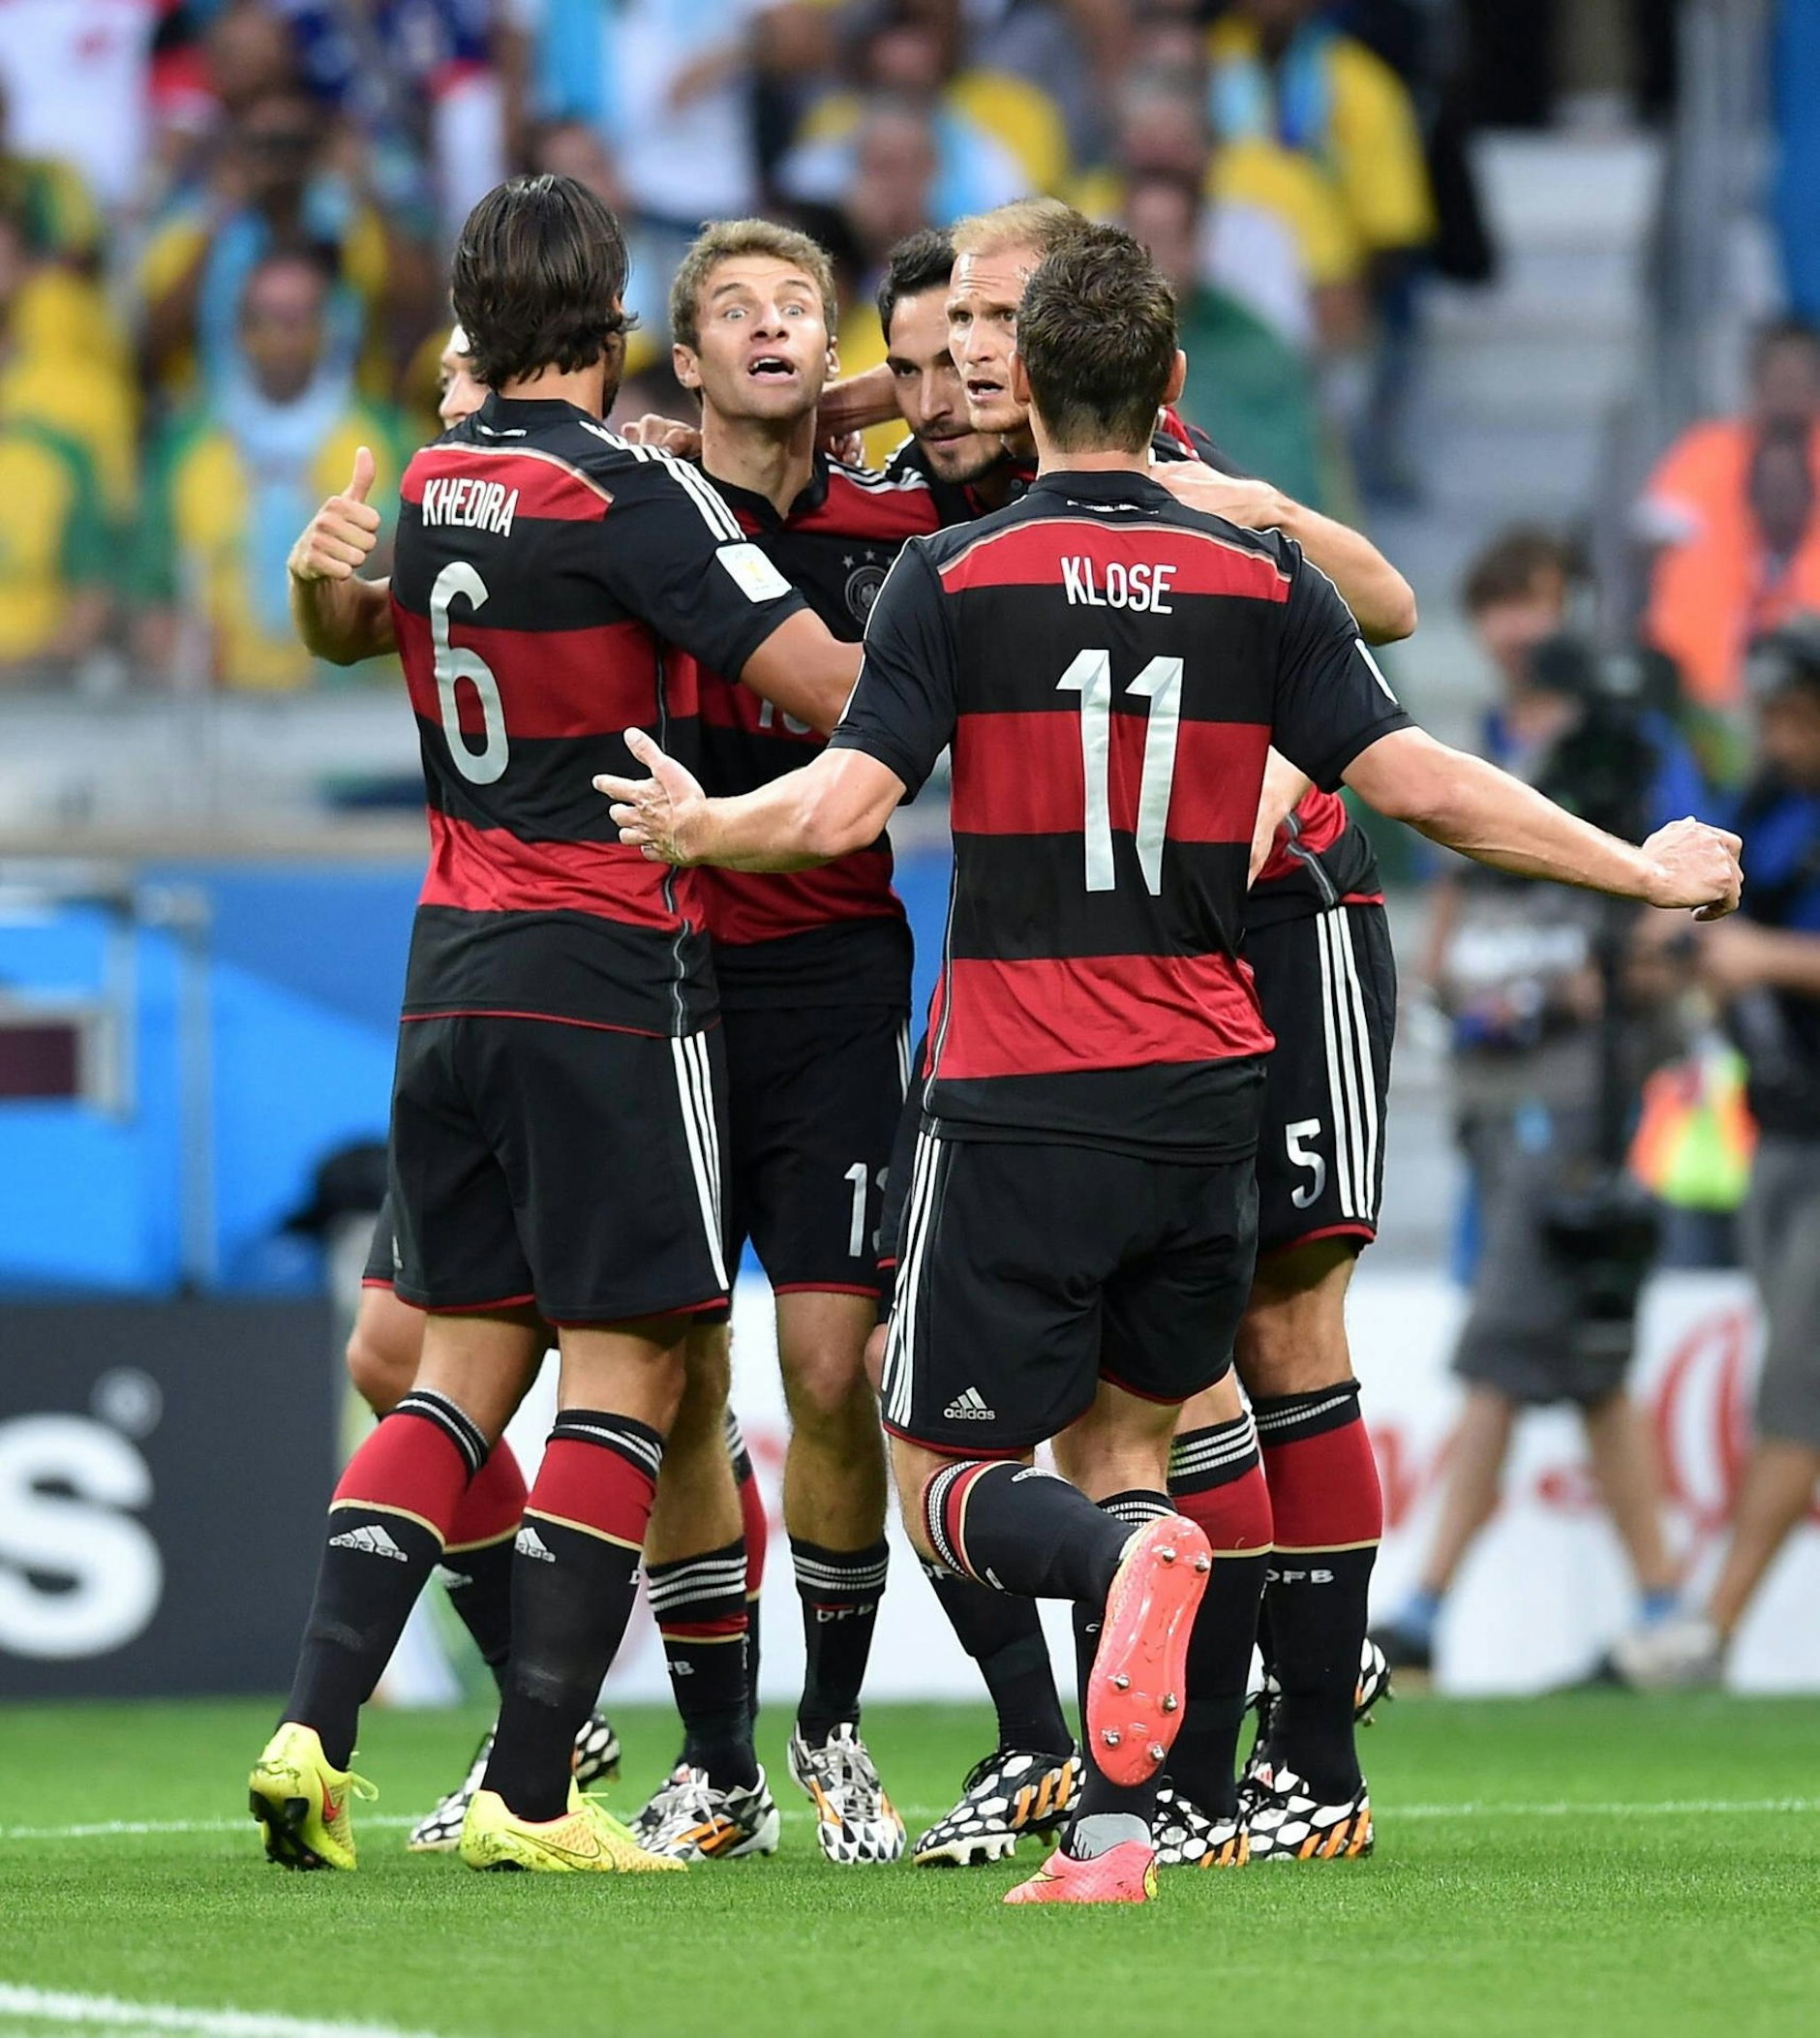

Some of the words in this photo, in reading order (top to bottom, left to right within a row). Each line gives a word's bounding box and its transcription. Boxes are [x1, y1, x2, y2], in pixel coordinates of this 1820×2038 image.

[422, 477, 520, 537] KHEDIRA
[1060, 555, 1177, 615] KLOSE
[430, 561, 509, 785] 6
[1055, 649, 1184, 897] 11
[1285, 1117, 1326, 1209] 5
[943, 1407, 996, 1420] adidas
